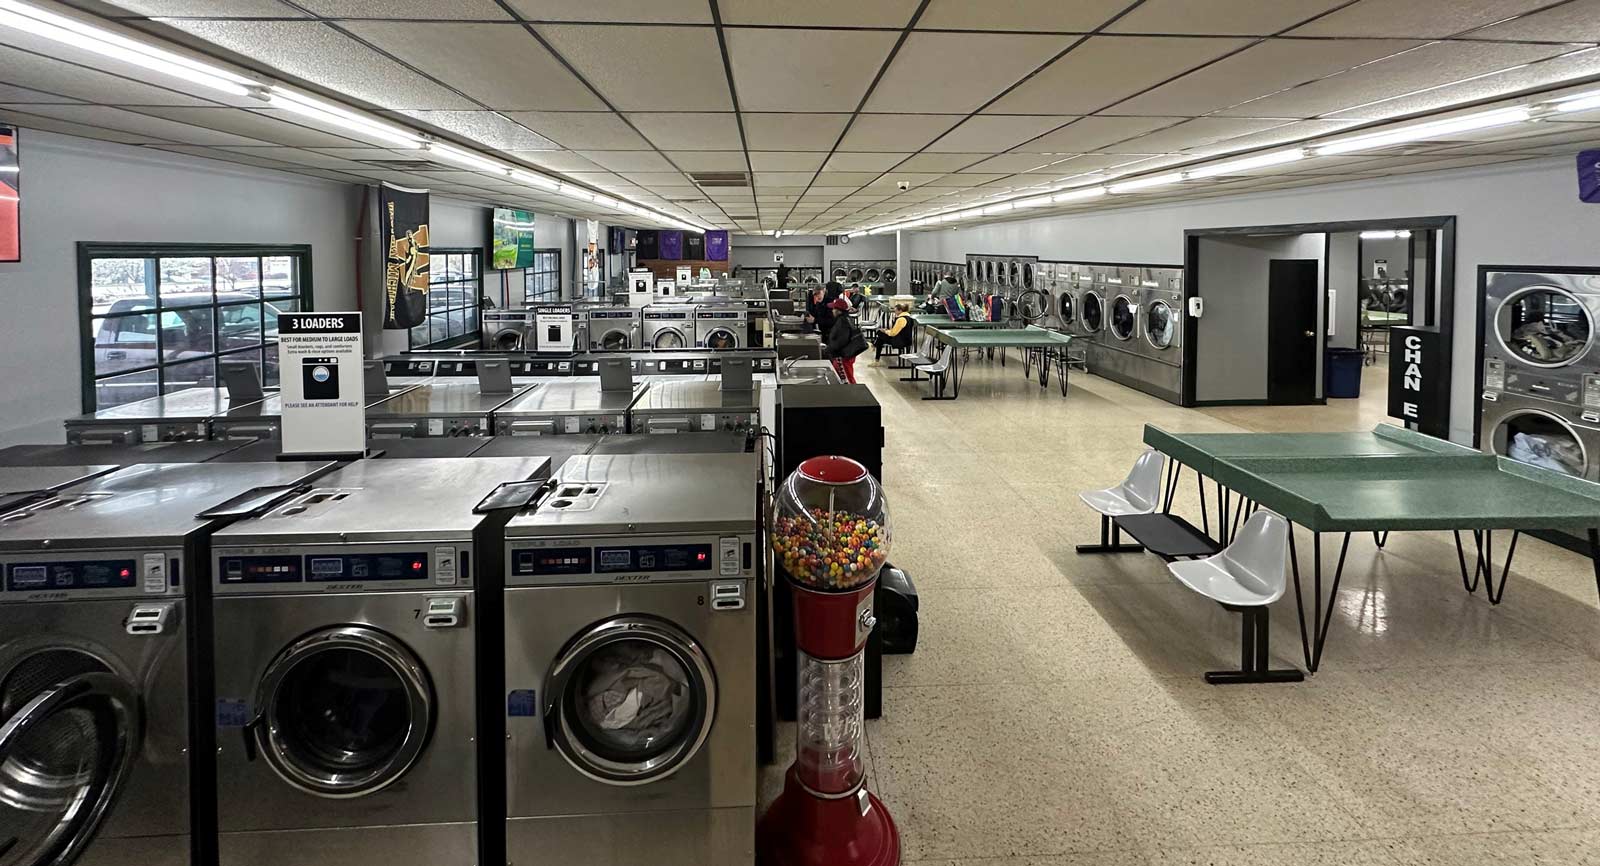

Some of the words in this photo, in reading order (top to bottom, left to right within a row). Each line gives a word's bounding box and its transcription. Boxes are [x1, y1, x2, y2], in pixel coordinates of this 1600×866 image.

[292, 318, 299, 329] 3
[301, 317, 344, 329] LOADERS
[696, 596, 704, 606] 8
[413, 608, 421, 619] 7
